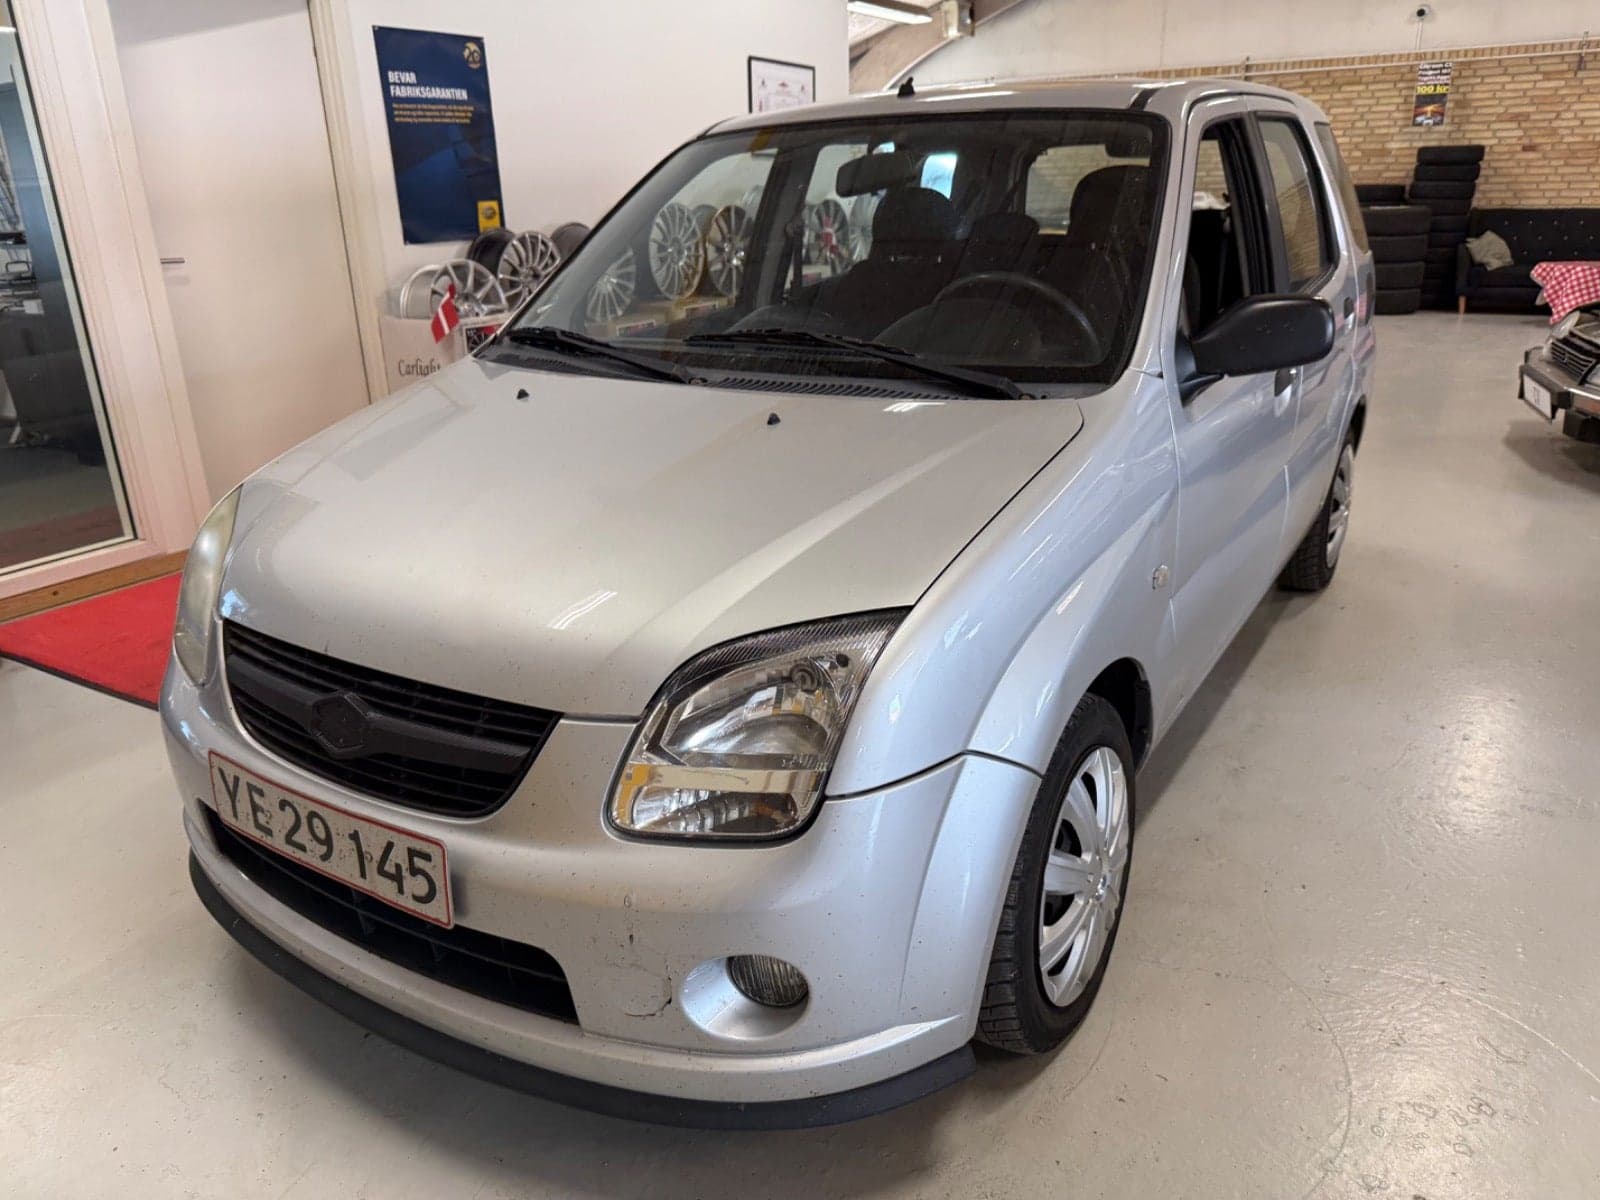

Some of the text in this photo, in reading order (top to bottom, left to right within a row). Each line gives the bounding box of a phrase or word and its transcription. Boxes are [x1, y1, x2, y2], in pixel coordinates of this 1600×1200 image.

[388, 70, 417, 84] BEVAR
[390, 85, 468, 101] FABRIKSGARANTIEN
[1416, 85, 1434, 94] 100
[348, 829, 437, 904] 145
